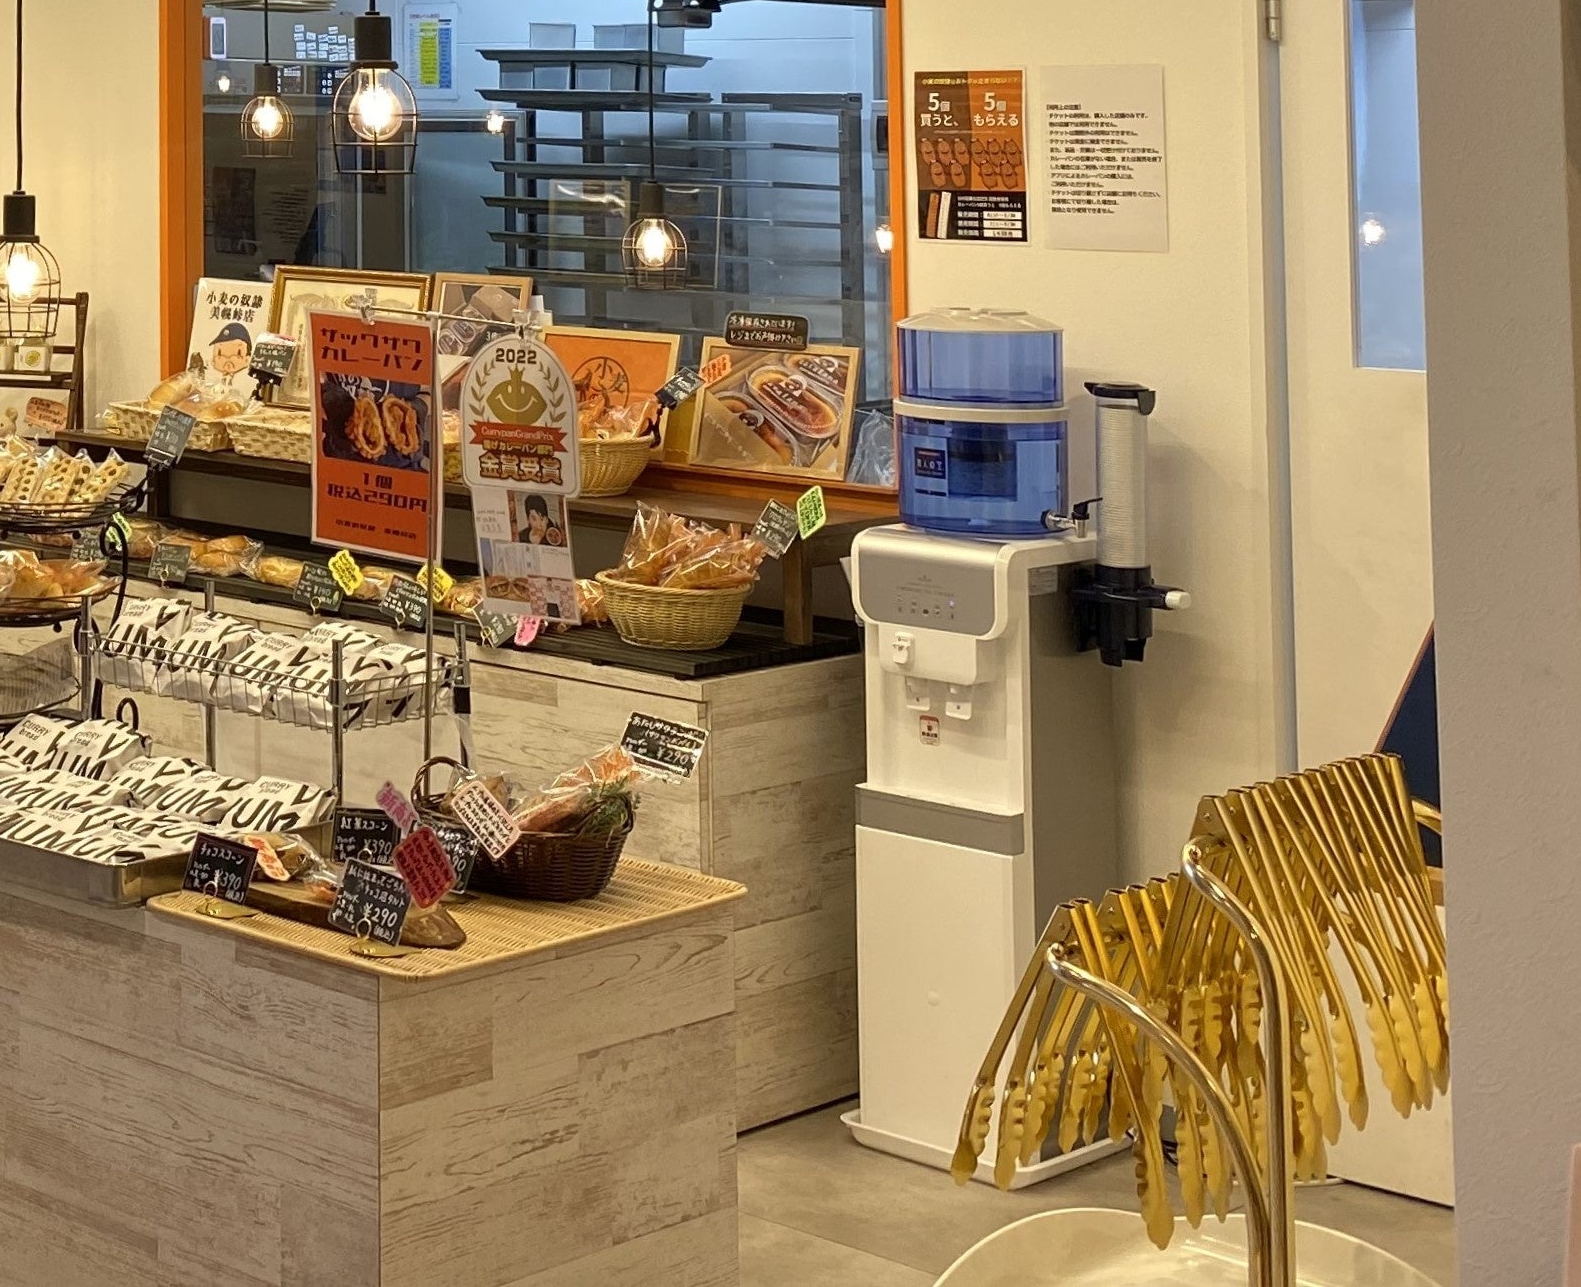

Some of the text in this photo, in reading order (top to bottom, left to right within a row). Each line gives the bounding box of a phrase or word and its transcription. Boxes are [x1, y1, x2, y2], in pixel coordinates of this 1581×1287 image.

[928, 92, 1007, 112] 5個 5個
[920, 113, 1019, 127] 買うと、 もらえる
[206, 291, 264, 308] 小麦の奴隷
[321, 345, 423, 372] カレーパン
[495, 348, 537, 364] 2022
[479, 450, 563, 485] 金賞受賞
[327, 482, 428, 513] 税込290円
[21, 720, 52, 737] CURRY
[656, 746, 689, 765] ¥290
[364, 902, 398, 928] ¥290
